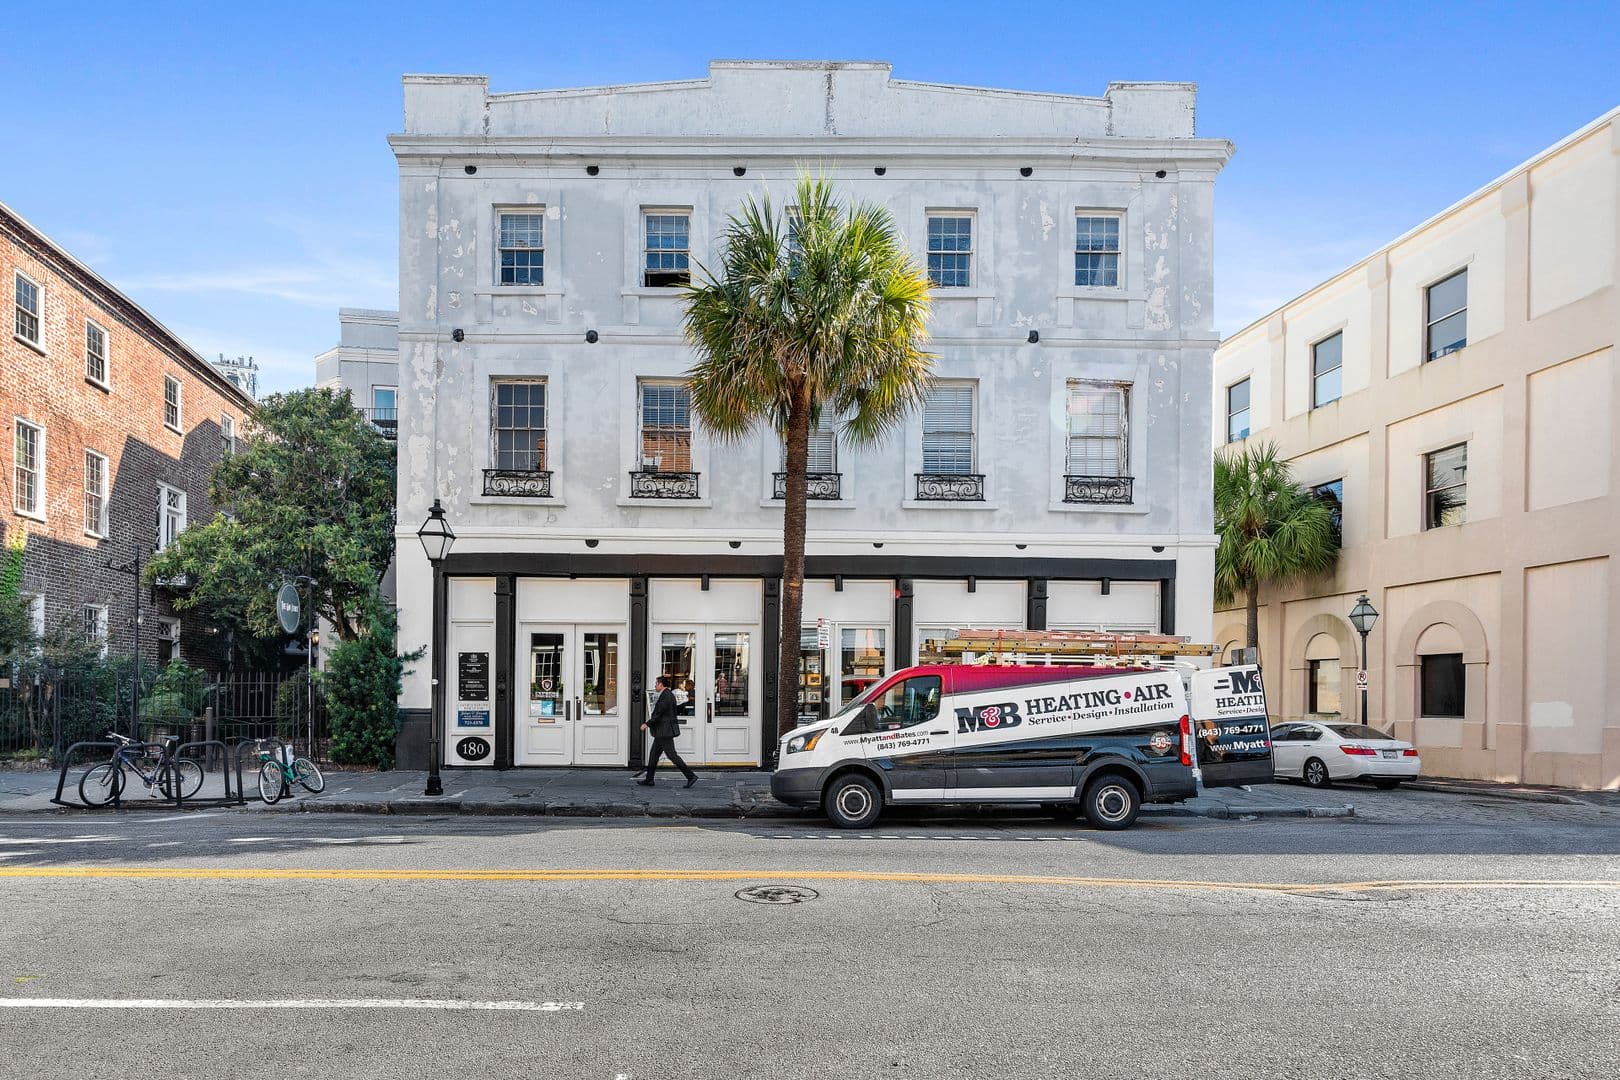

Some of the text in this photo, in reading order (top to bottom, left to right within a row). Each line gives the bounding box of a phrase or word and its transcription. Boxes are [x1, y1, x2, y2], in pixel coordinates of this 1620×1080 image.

[1025, 683, 1172, 716] HEATING AIR
[954, 702, 1022, 734] M&B
[1028, 701, 1174, 726] Service Design Installation
[1217, 706, 1242, 716] Service
[843, 730, 929, 746] www.MyattandBates.com
[1198, 724, 1264, 738] (843) 769-4771
[462, 742, 484, 756] 180
[877, 738, 930, 752] (843) 769-4771
